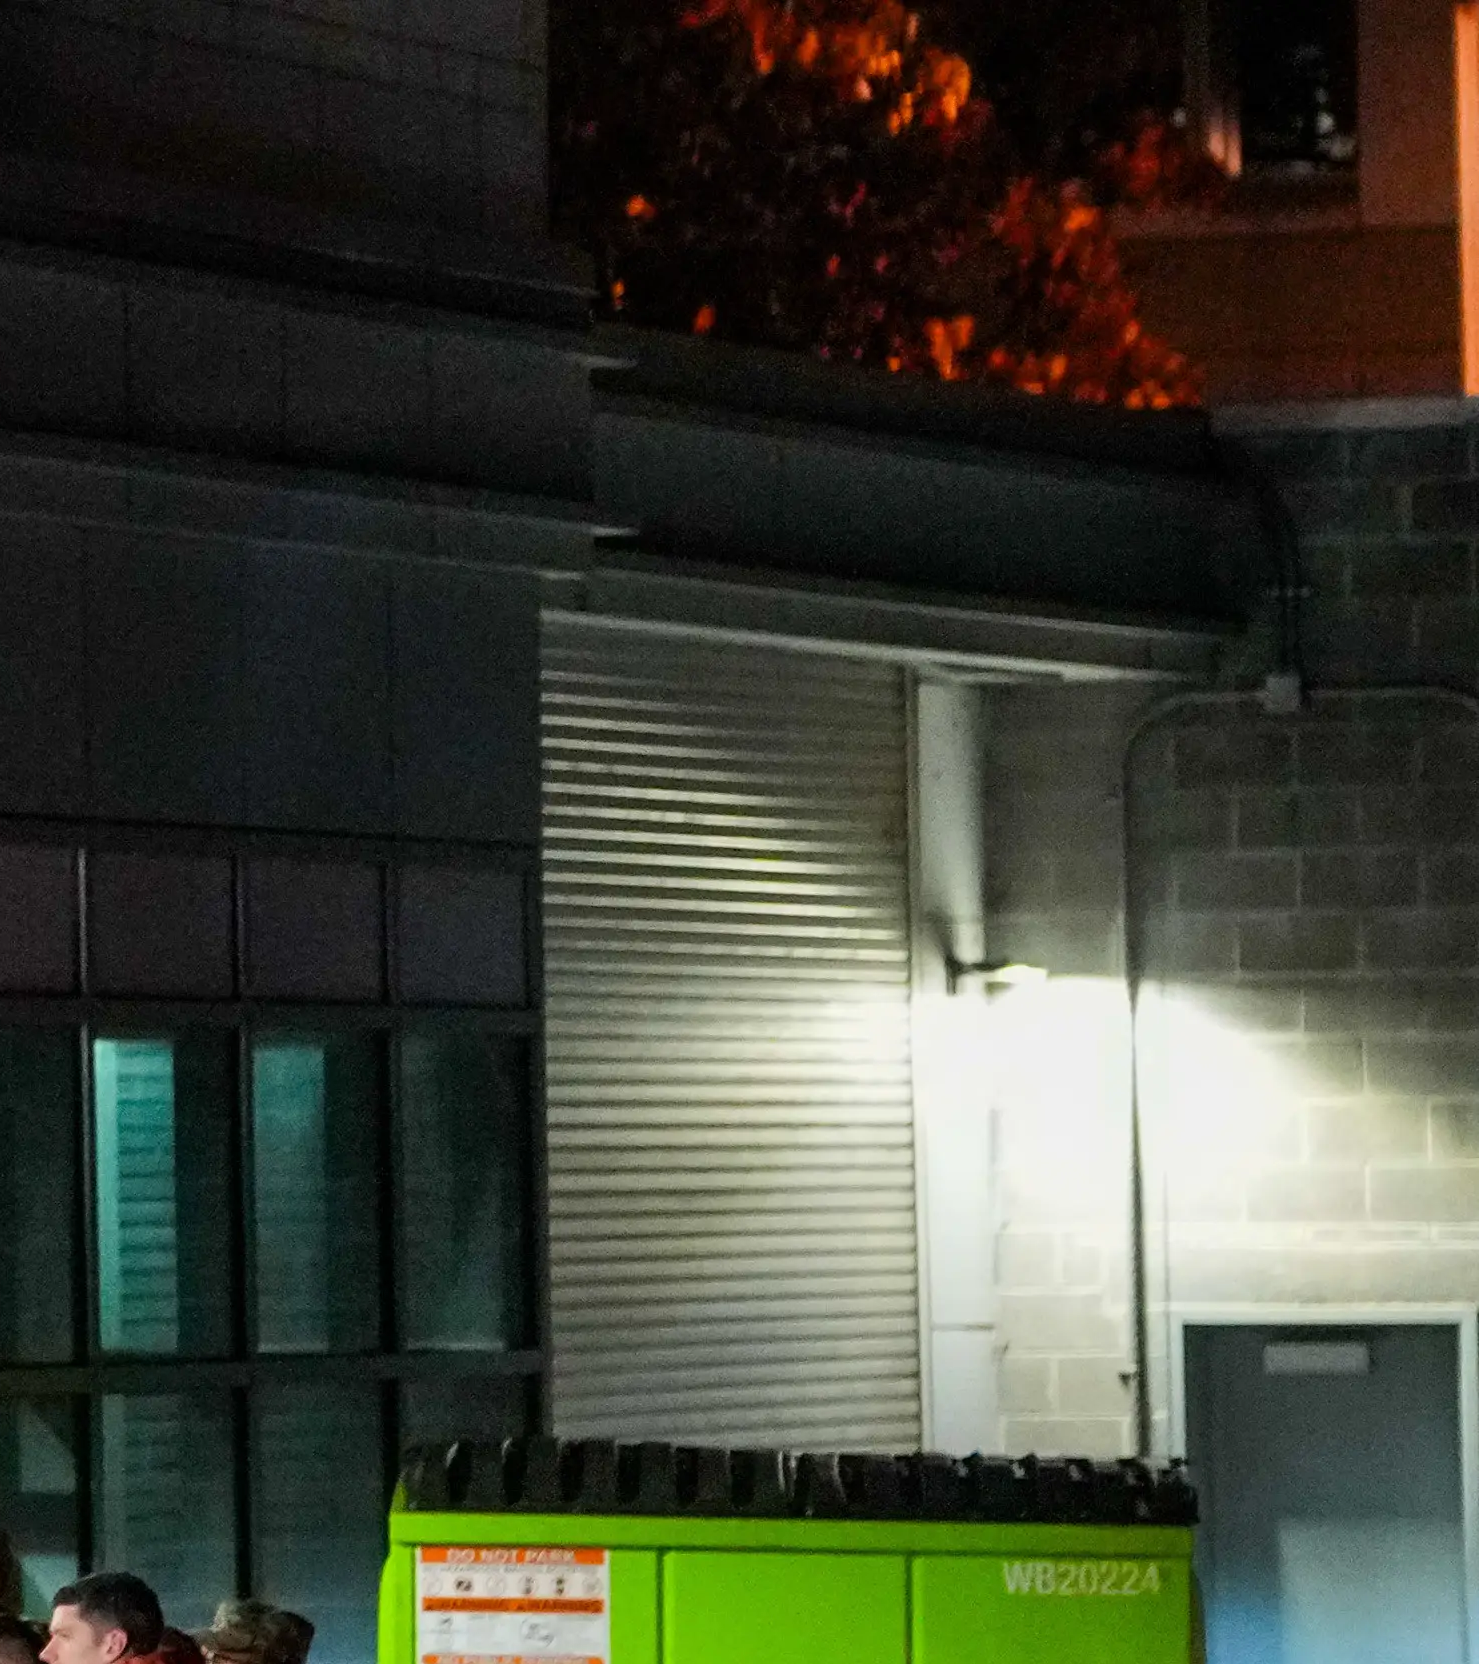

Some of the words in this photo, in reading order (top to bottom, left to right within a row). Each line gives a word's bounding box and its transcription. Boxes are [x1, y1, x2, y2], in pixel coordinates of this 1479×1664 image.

[448, 1548, 475, 1563] DO
[481, 1548, 518, 1563] NOT
[525, 1549, 575, 1564] PARK
[1003, 1560, 1161, 1595] WB20224
